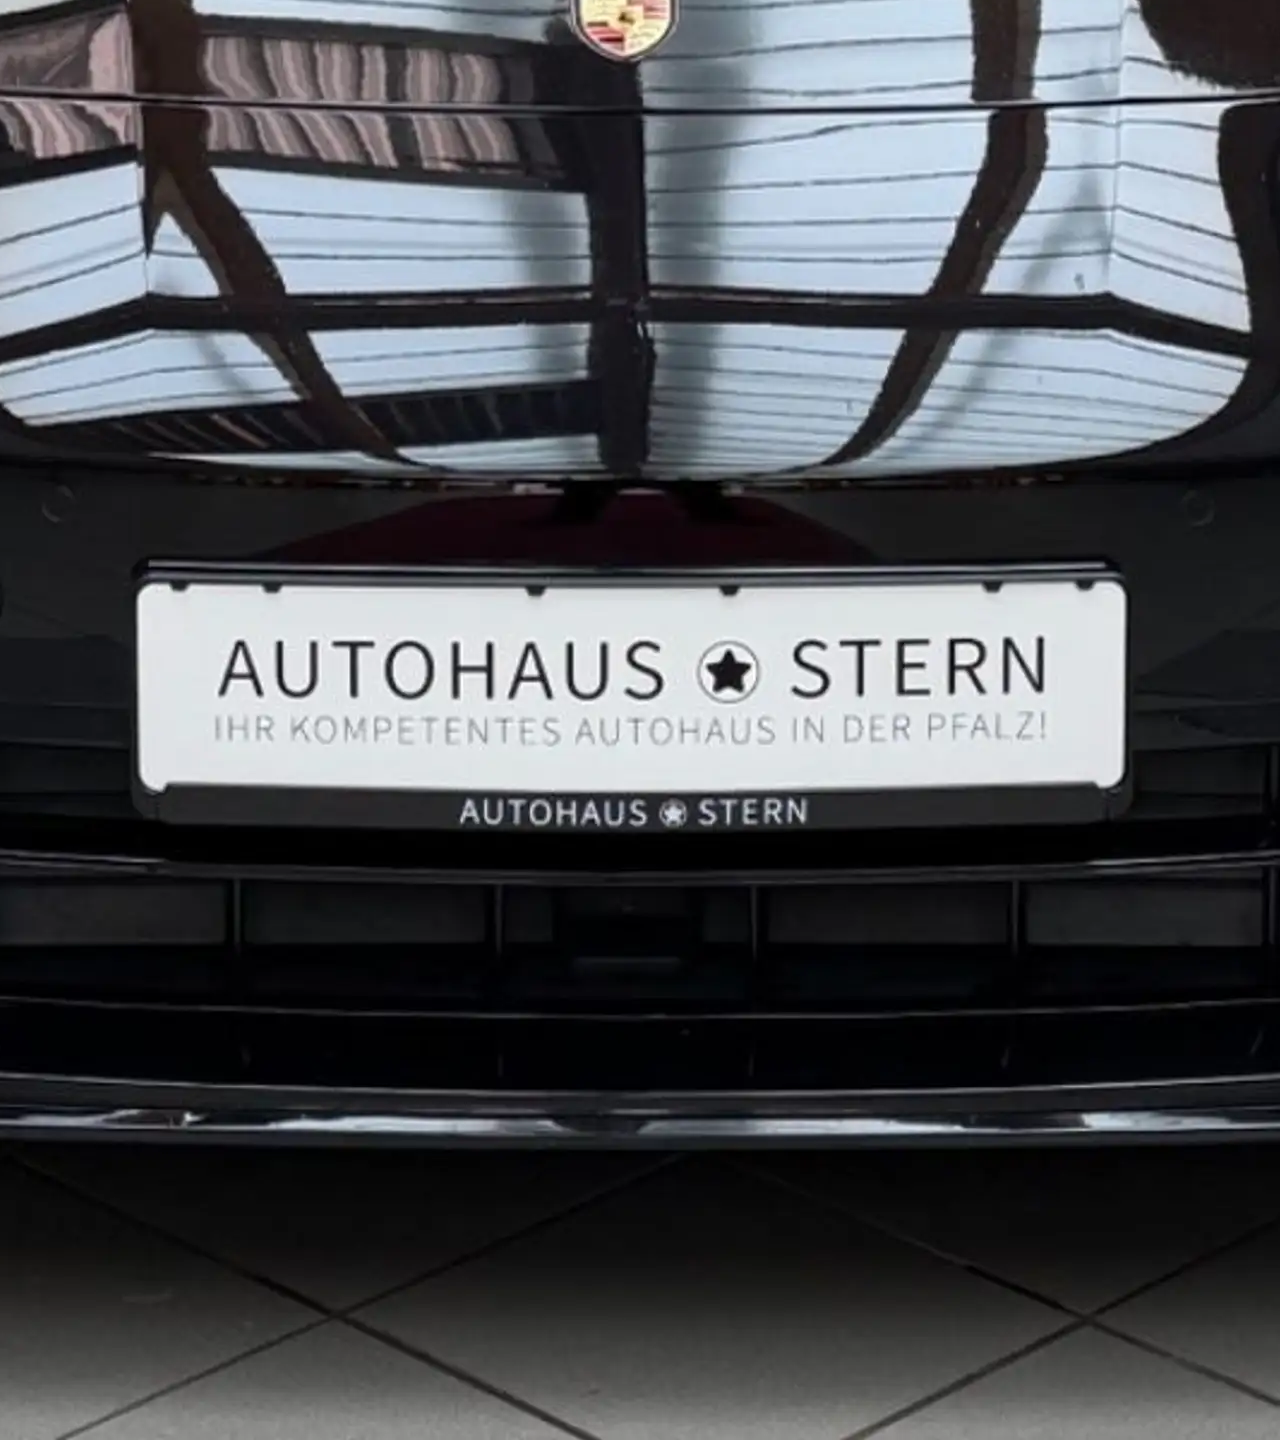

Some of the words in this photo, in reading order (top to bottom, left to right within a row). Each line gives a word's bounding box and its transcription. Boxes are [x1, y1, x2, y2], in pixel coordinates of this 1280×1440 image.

[218, 640, 664, 700] AUTOHAUS
[791, 636, 1045, 699] STERN
[214, 715, 275, 742] IHR
[289, 714, 561, 746] KOMPETENTES
[574, 715, 776, 747] AUTOHAUS
[792, 715, 825, 744] IN
[843, 714, 912, 744] DER
[927, 711, 1048, 742] PFALZ!
[460, 798, 649, 827] AUTOHAUS
[697, 797, 809, 827] STERN
